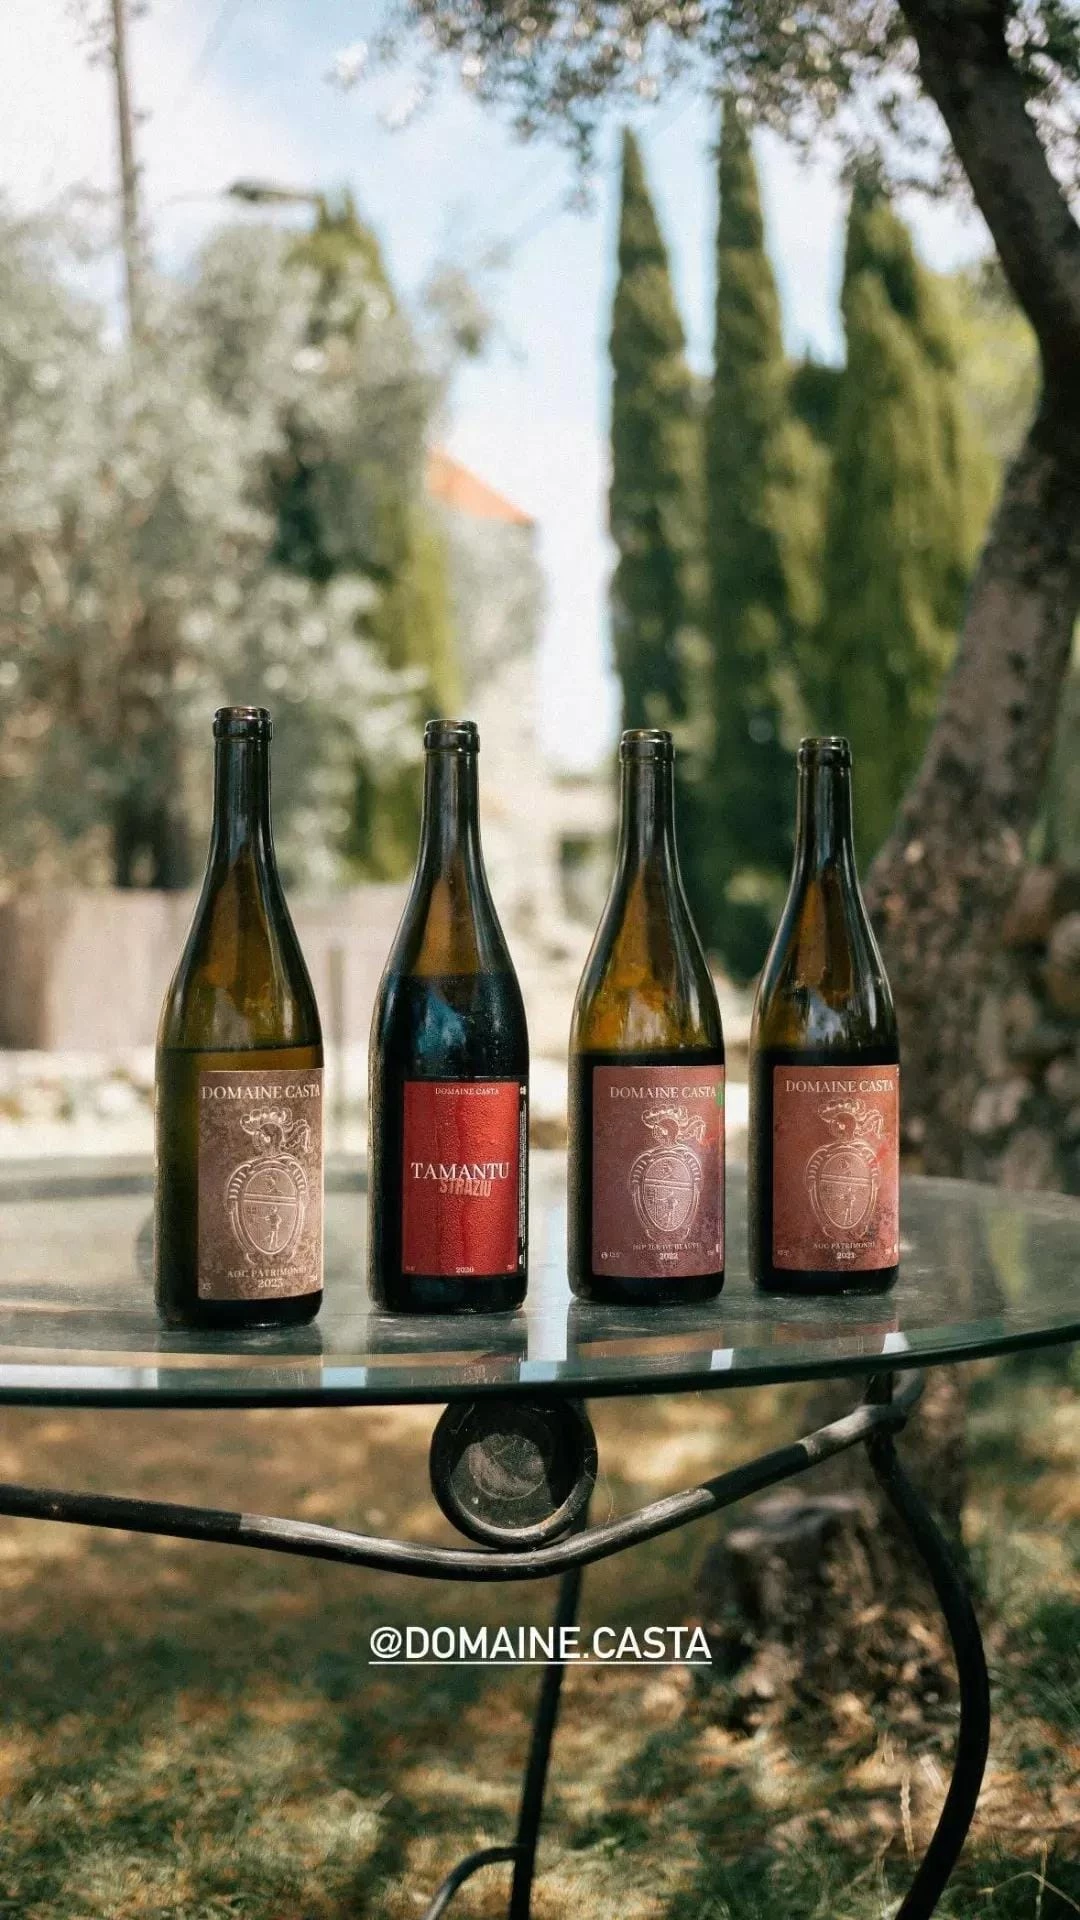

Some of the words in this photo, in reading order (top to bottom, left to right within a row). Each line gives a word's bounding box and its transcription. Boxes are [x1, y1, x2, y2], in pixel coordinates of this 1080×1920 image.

[201, 1085, 282, 1100] DOMAINE
[285, 1083, 321, 1099] CASTA
[435, 1087, 474, 1095] DOMAINE
[475, 1087, 499, 1095] CASTA
[609, 1086, 678, 1099] DOMAINE
[681, 1086, 717, 1098] CASTA
[785, 1079, 856, 1093] DOMAINE
[858, 1079, 894, 1092] CASTA
[410, 1162, 510, 1180] TAMANTU
[439, 1178, 491, 1197] STRAZIU
[455, 1266, 474, 1274] 2020
